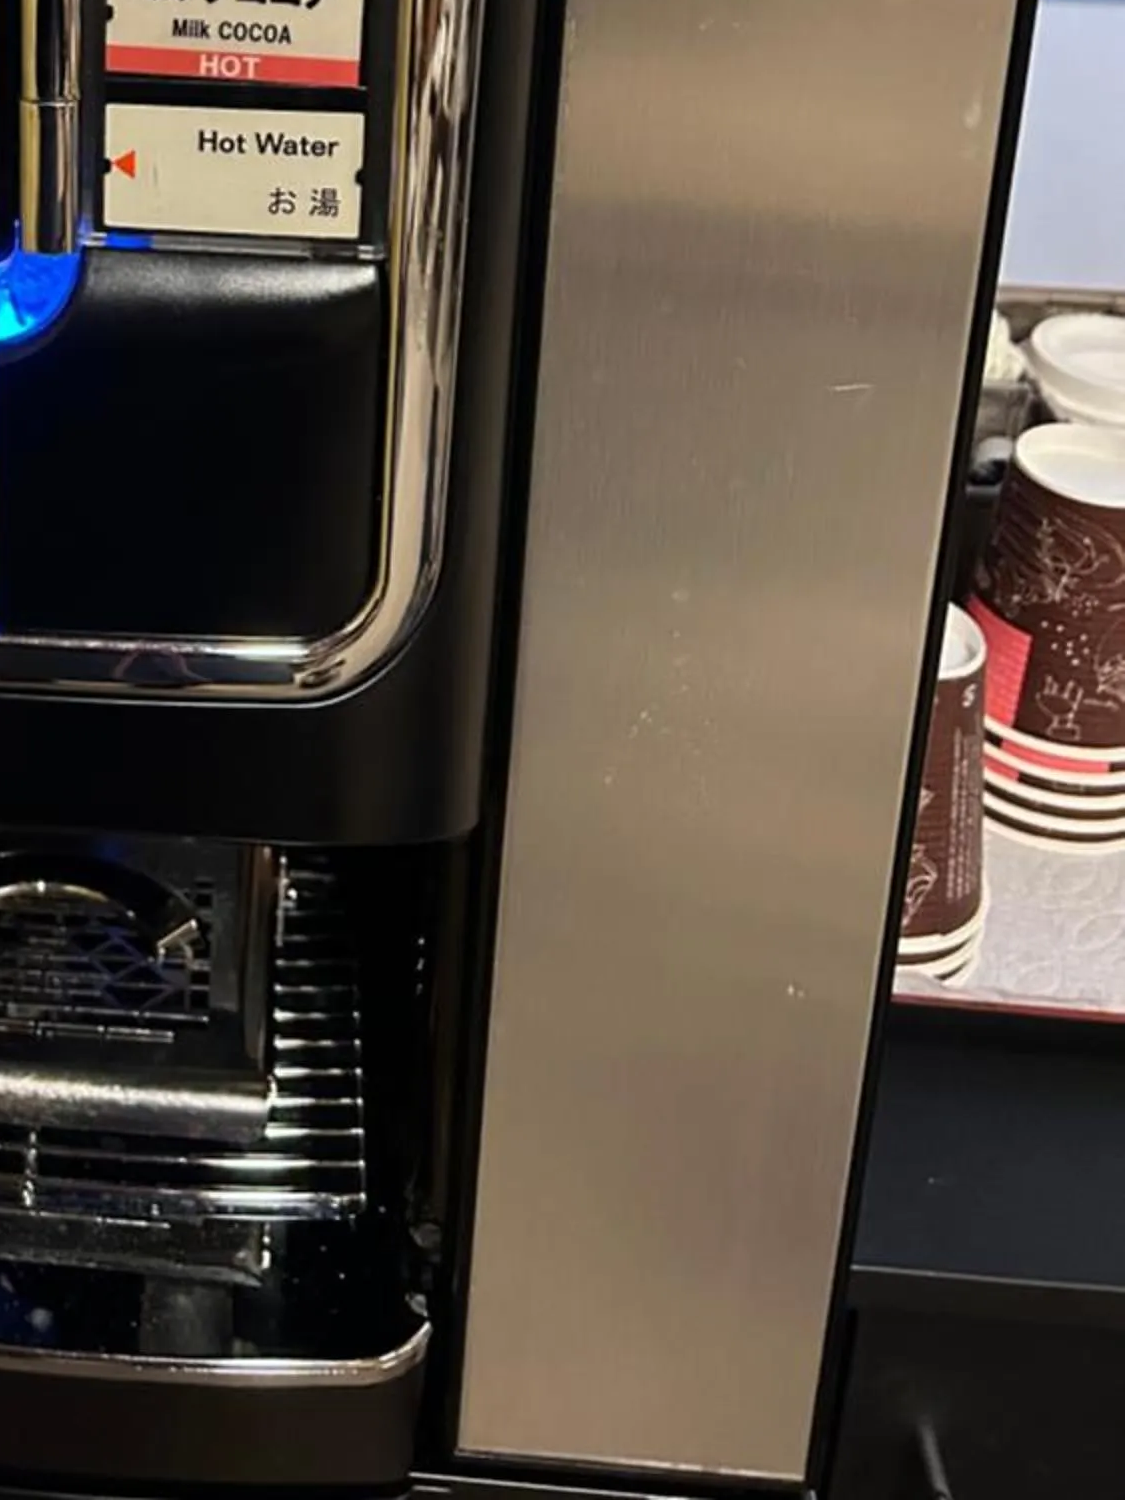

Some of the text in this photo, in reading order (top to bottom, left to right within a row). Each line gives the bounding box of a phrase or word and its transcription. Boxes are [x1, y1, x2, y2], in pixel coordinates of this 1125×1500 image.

[172, 18, 292, 45] Milk COCOA
[199, 53, 261, 80] HOT
[197, 129, 340, 158] Hot Water
